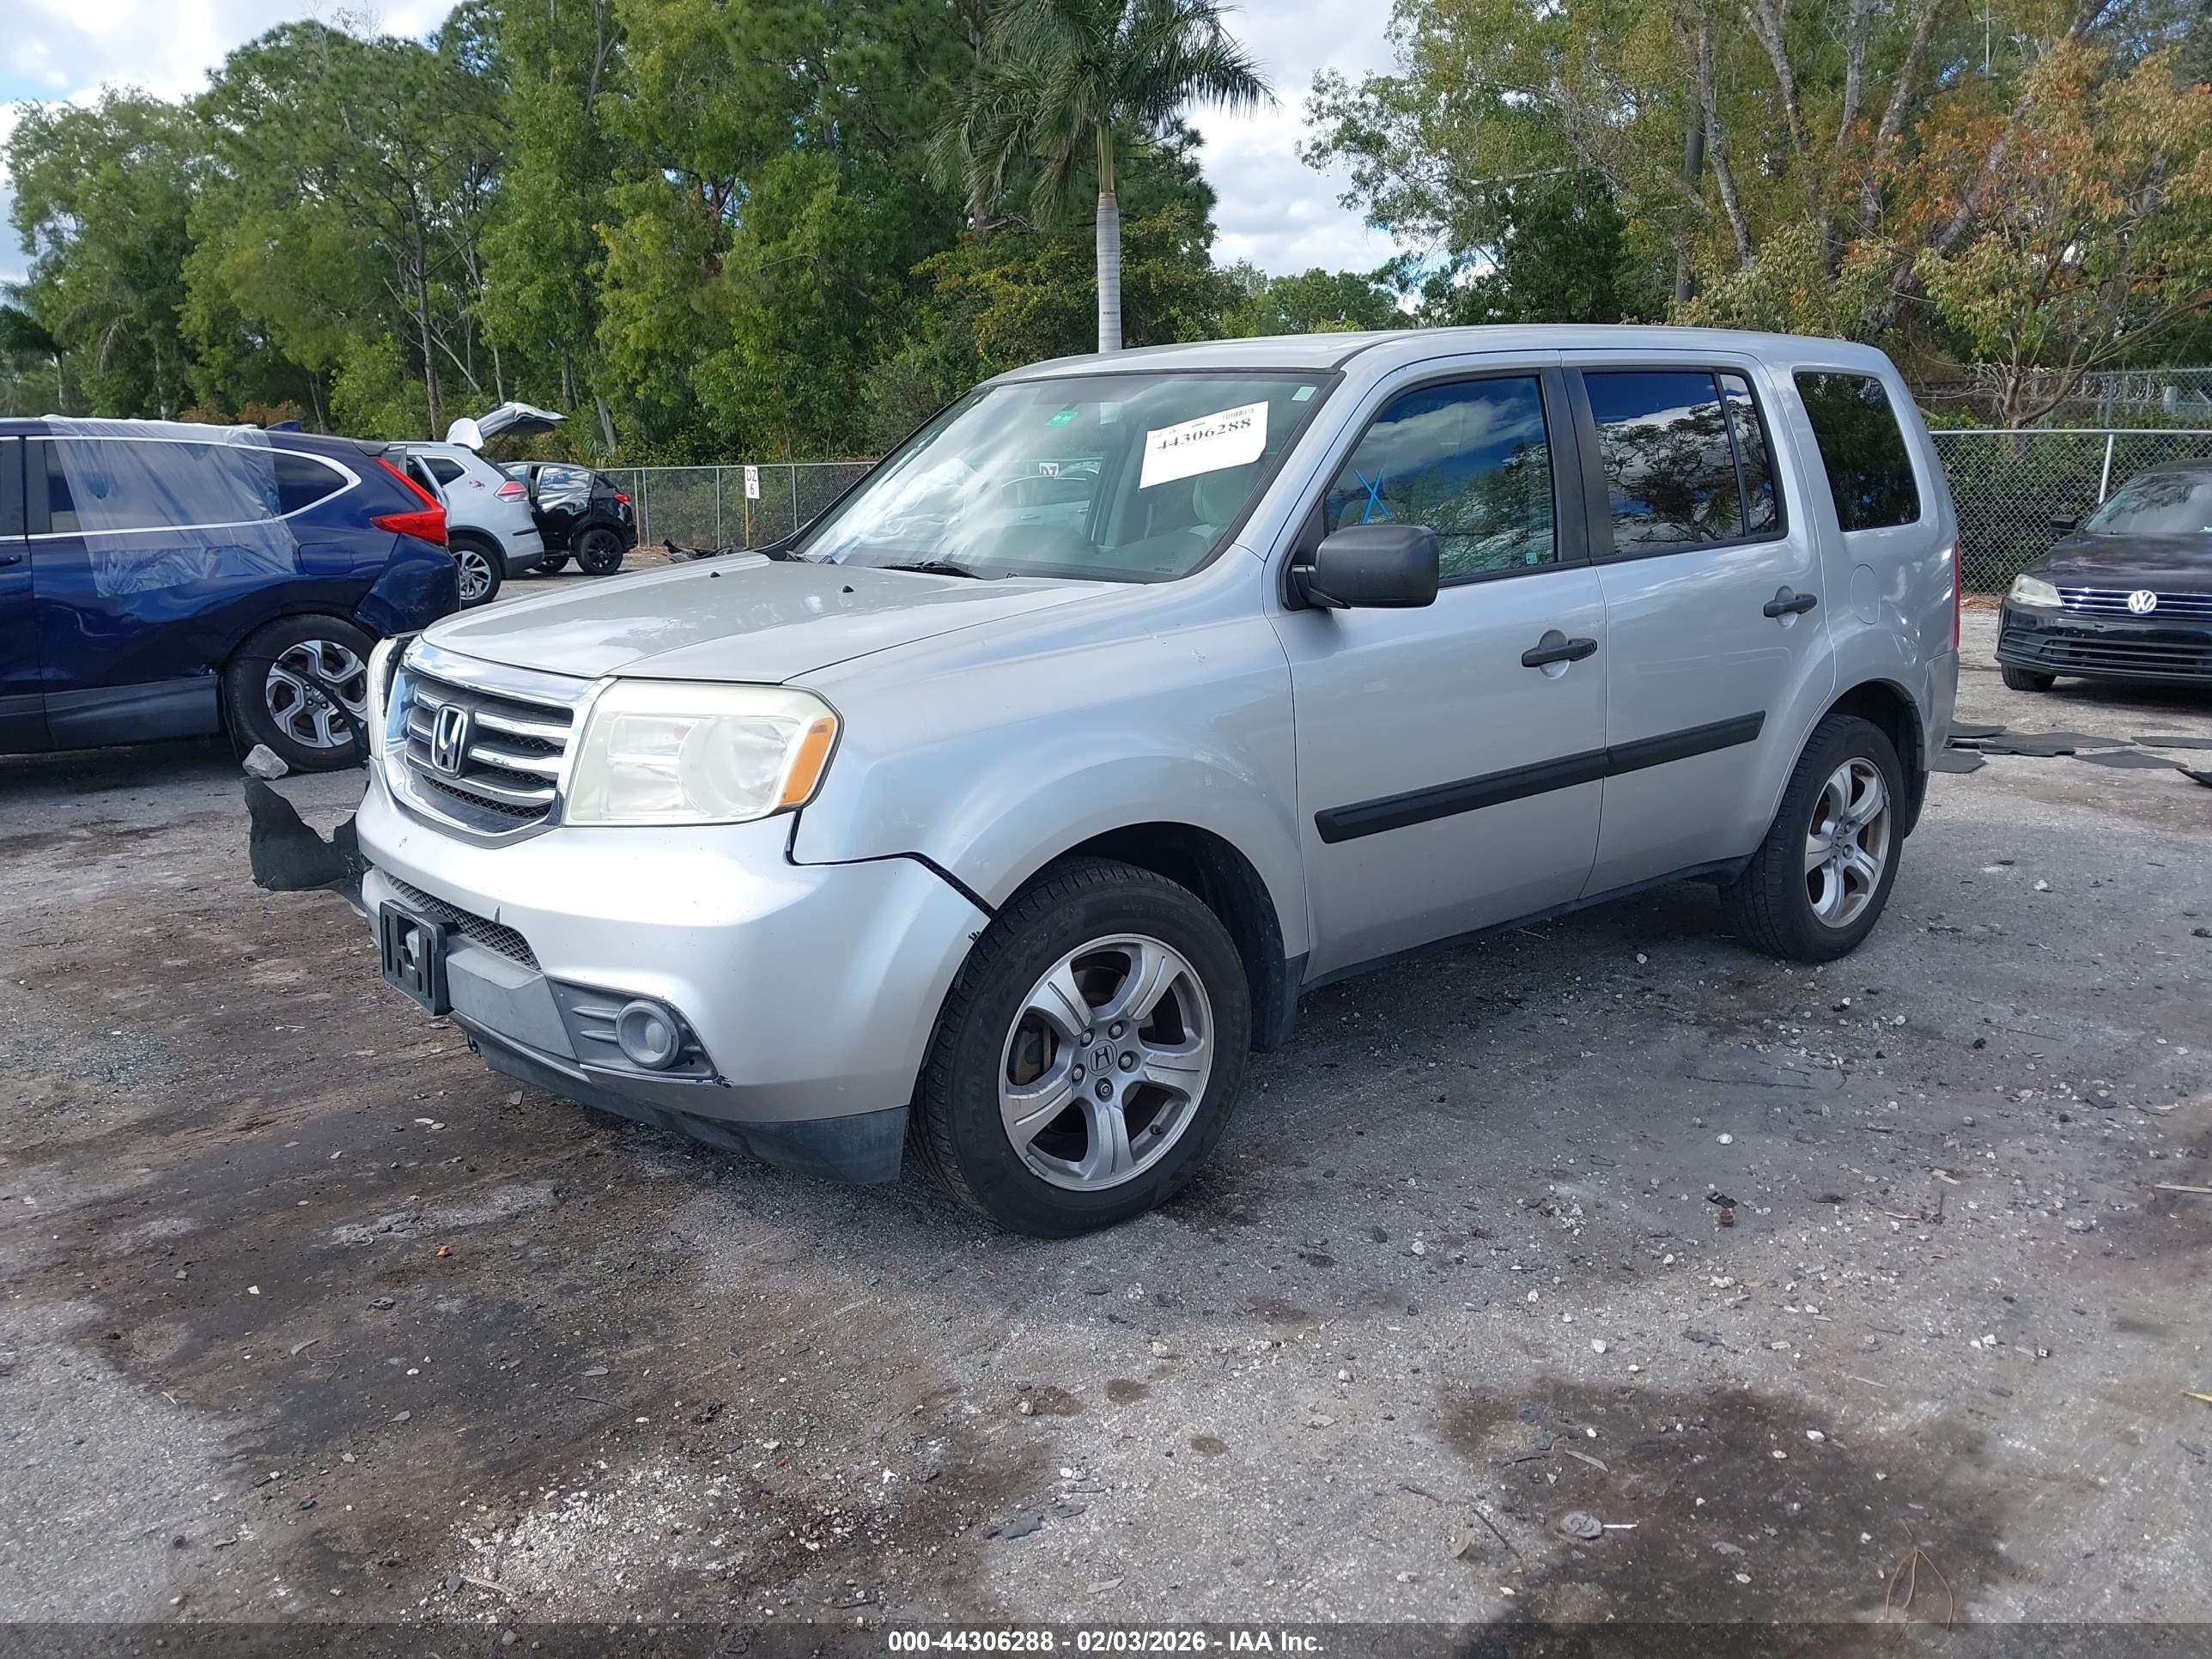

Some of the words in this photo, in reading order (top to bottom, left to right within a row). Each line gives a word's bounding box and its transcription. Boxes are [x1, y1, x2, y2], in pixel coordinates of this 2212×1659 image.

[1157, 417, 1251, 449] 44306288
[746, 469, 757, 482] DZ
[750, 483, 755, 495] 6
